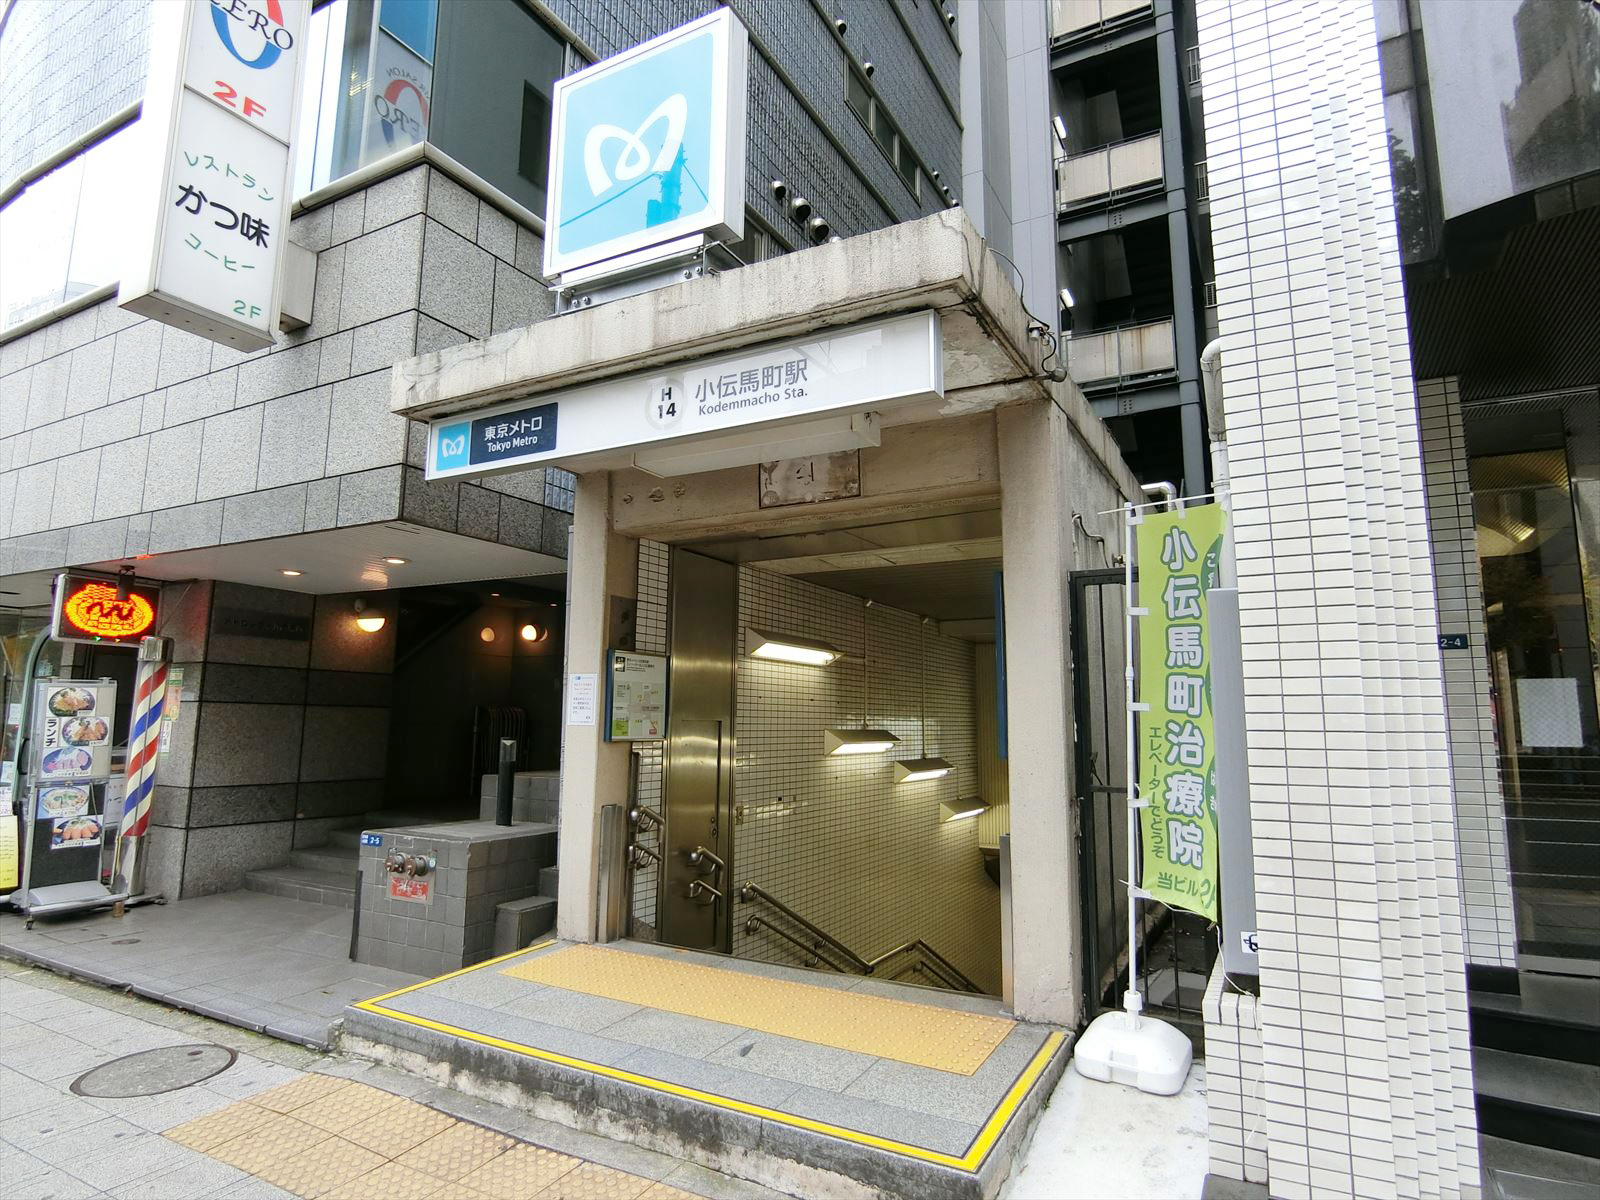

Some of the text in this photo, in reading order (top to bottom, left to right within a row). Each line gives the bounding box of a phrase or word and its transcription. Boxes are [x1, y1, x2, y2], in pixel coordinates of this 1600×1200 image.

[208, 0, 293, 50] ERO
[213, 80, 267, 118] 2F
[184, 151, 274, 200] レストラン
[175, 184, 270, 248] かつ味
[184, 233, 255, 271] コーヒー
[233, 300, 262, 318] 2F
[661, 386, 673, 402] H
[695, 358, 808, 403] 小伝馬町駅
[657, 402, 677, 419] 14
[699, 386, 808, 416] Kodemmacho Sta.
[484, 416, 543, 441] 東京メトロ
[487, 435, 538, 453] Tokyo Metro
[1440, 638, 1461, 647] 2-4
[1160, 525, 1205, 870] 小伝馬町治療院
[46, 718, 57, 748] ランチ
[1149, 727, 1164, 858] エレベーターでどうぞ
